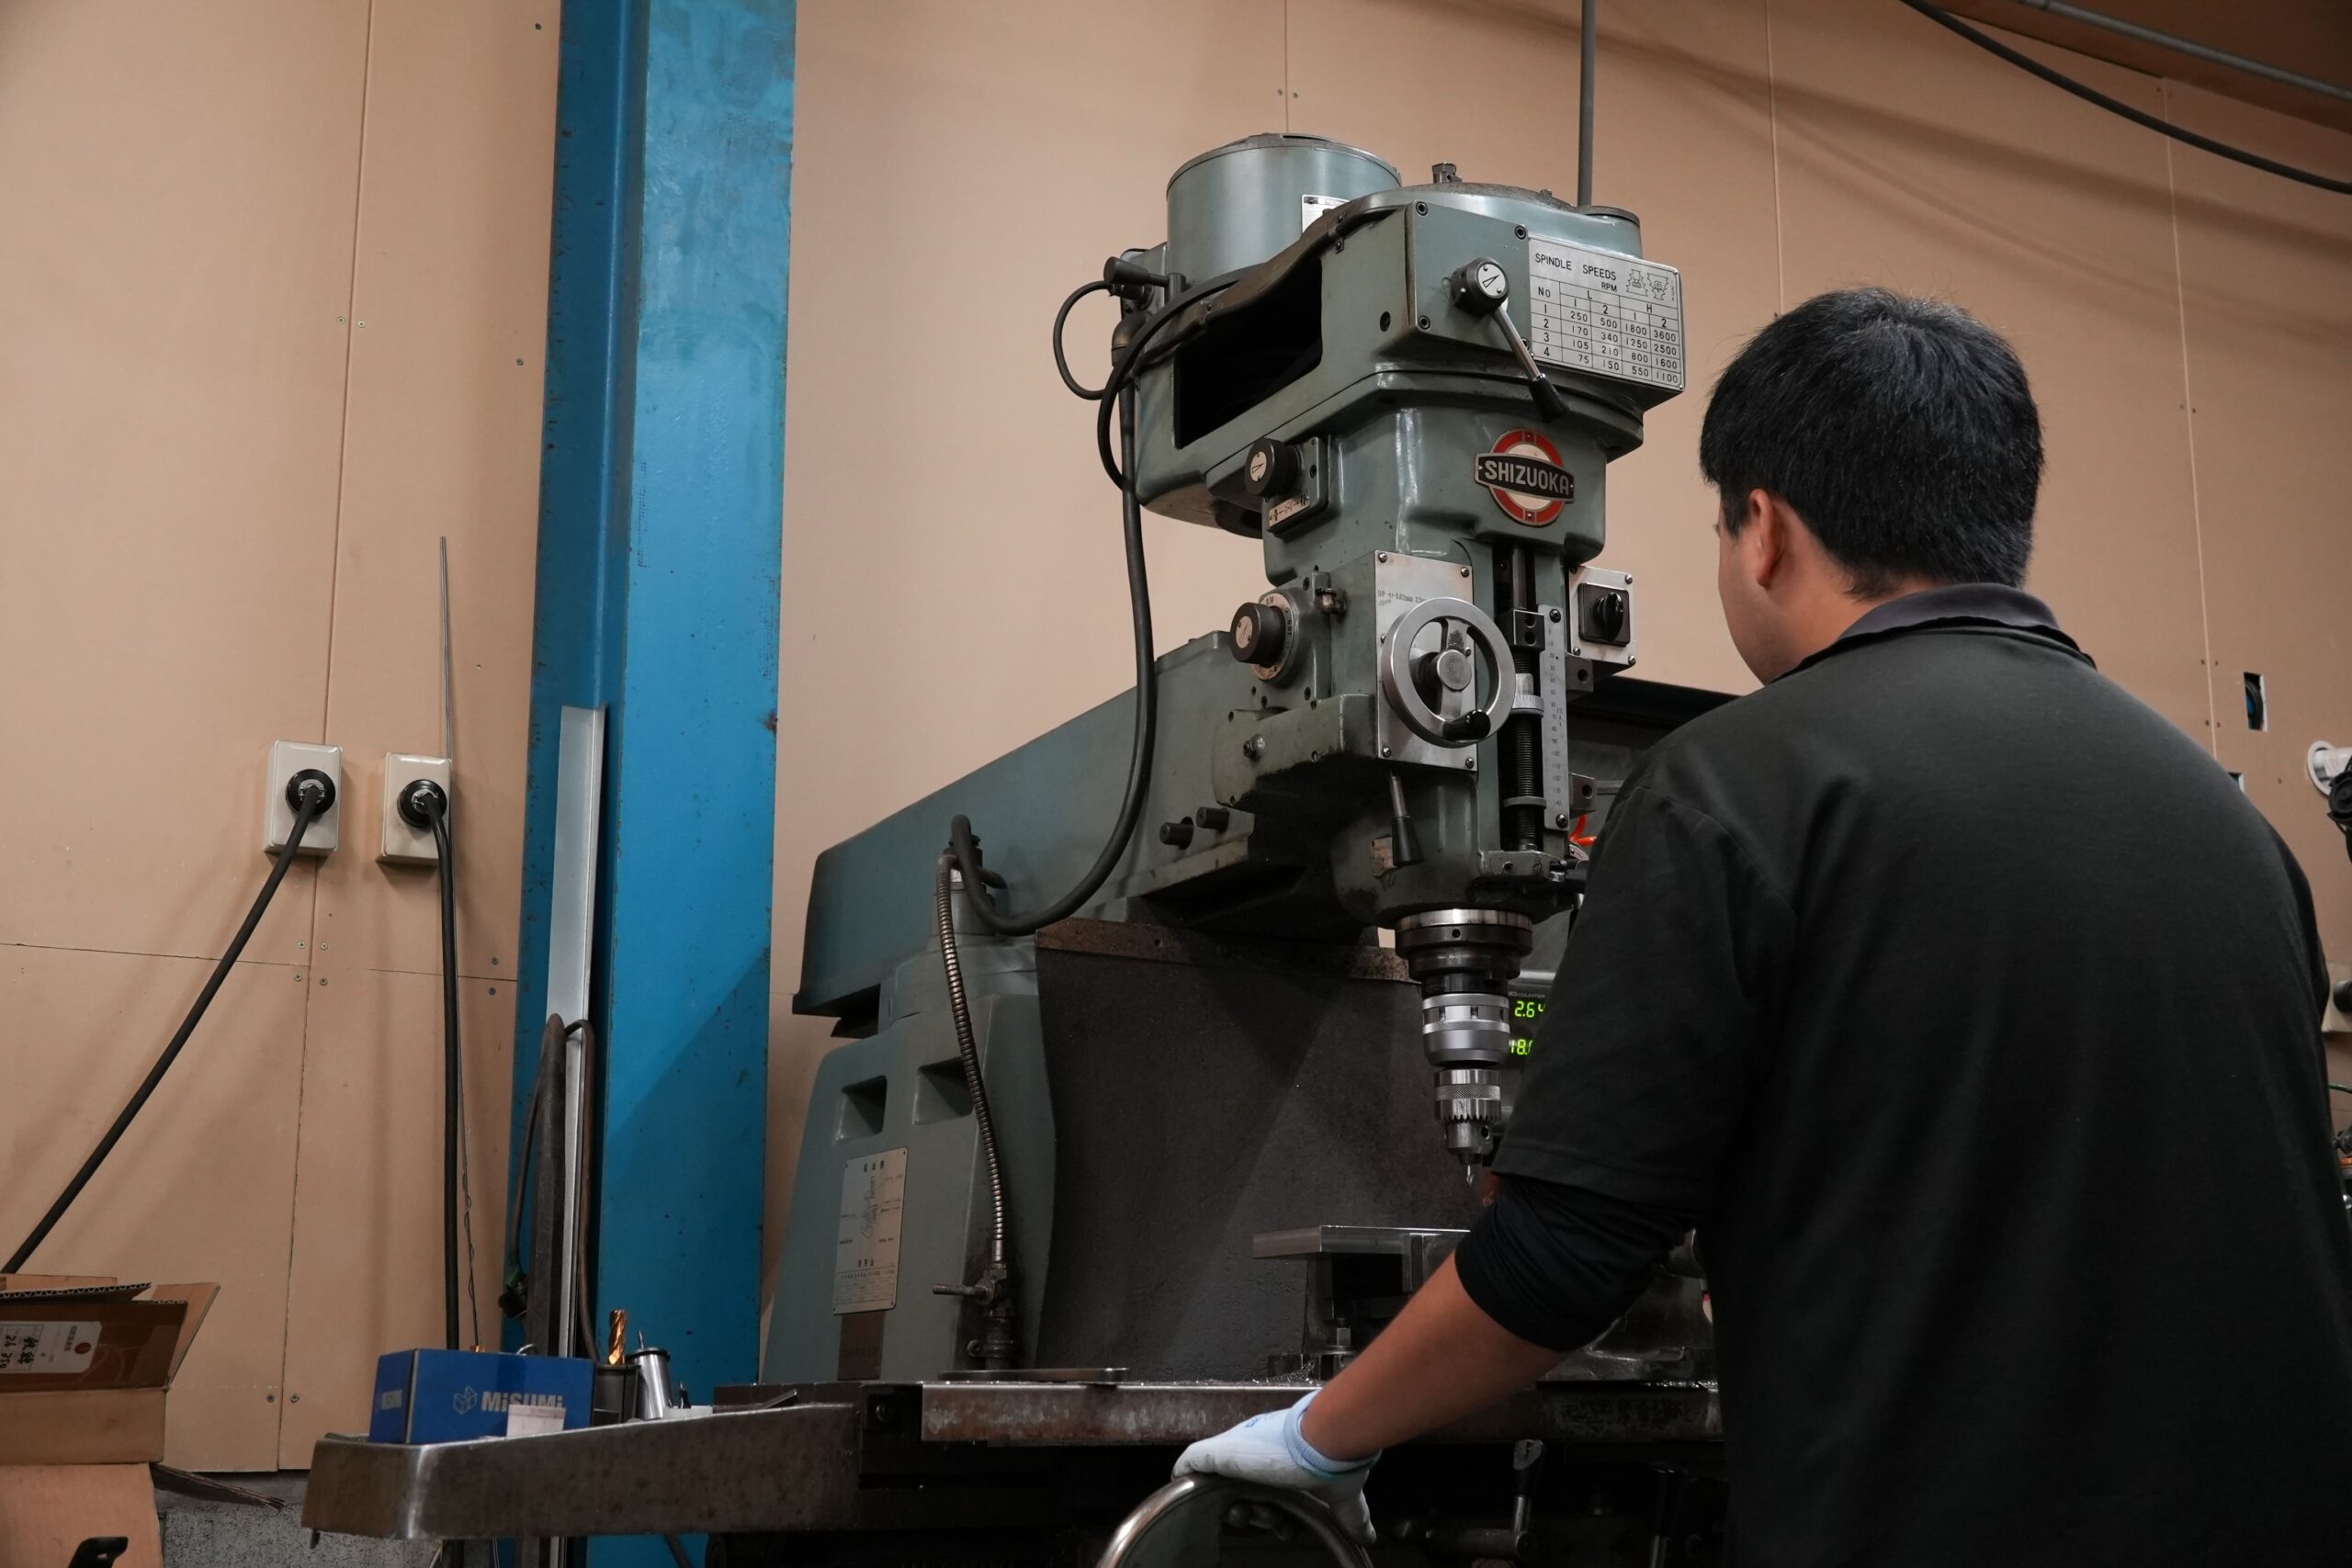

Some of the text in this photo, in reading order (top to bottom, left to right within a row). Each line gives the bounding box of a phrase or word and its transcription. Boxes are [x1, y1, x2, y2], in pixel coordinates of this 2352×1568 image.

[1535, 254, 1617, 281] SPINDLE SPEEDS
[1587, 290, 1653, 313] L H
[1601, 282, 1617, 292] RPM
[1570, 310, 1588, 322] 250
[1600, 318, 1617, 329] 500
[1625, 323, 1647, 335] 1800
[1654, 330, 1677, 342] 3600
[1602, 305, 1608, 314] 2
[1661, 319, 1667, 328] 2
[1544, 319, 1677, 355] 2 170 340 1250 2500
[1544, 333, 1678, 368] 3 105 210 800 1600
[1544, 347, 1679, 383] 4 75 150 550 1100
[1485, 460, 1569, 495] SHIZUOKA
